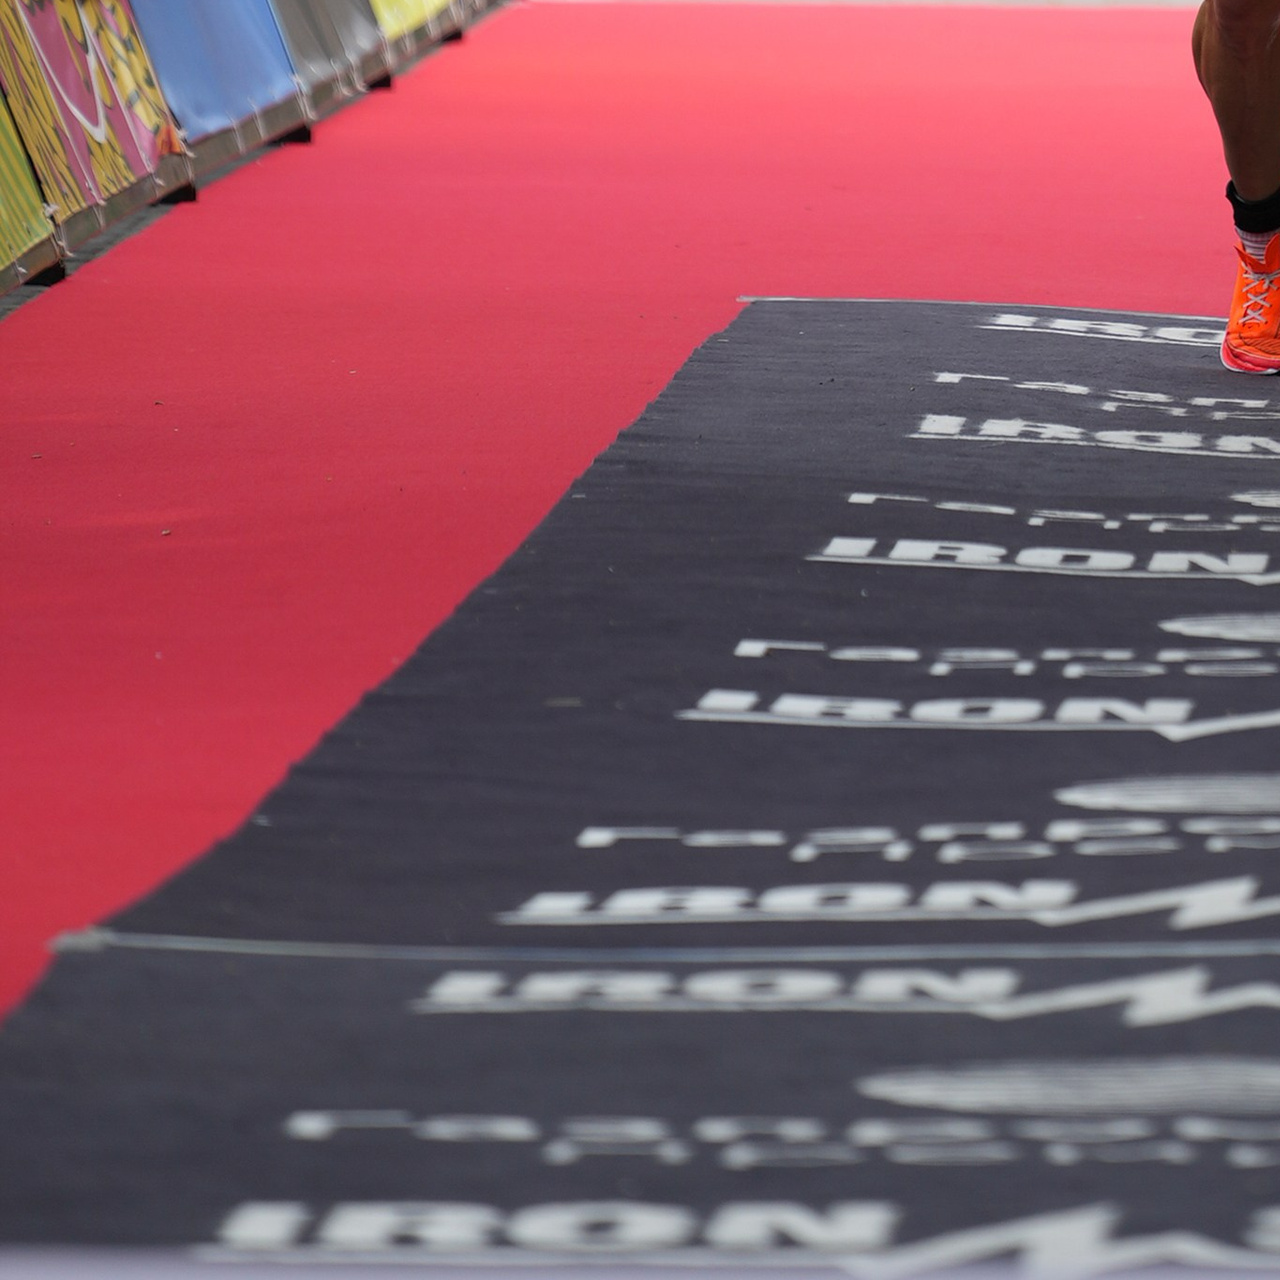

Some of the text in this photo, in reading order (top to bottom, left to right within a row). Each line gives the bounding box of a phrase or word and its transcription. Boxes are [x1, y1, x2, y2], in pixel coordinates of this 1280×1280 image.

[822, 536, 1270, 573] IRON
[696, 688, 1193, 723] IRON
[519, 878, 1076, 917] IRON
[430, 966, 1018, 1002] IRON
[219, 1199, 898, 1253] IRON
